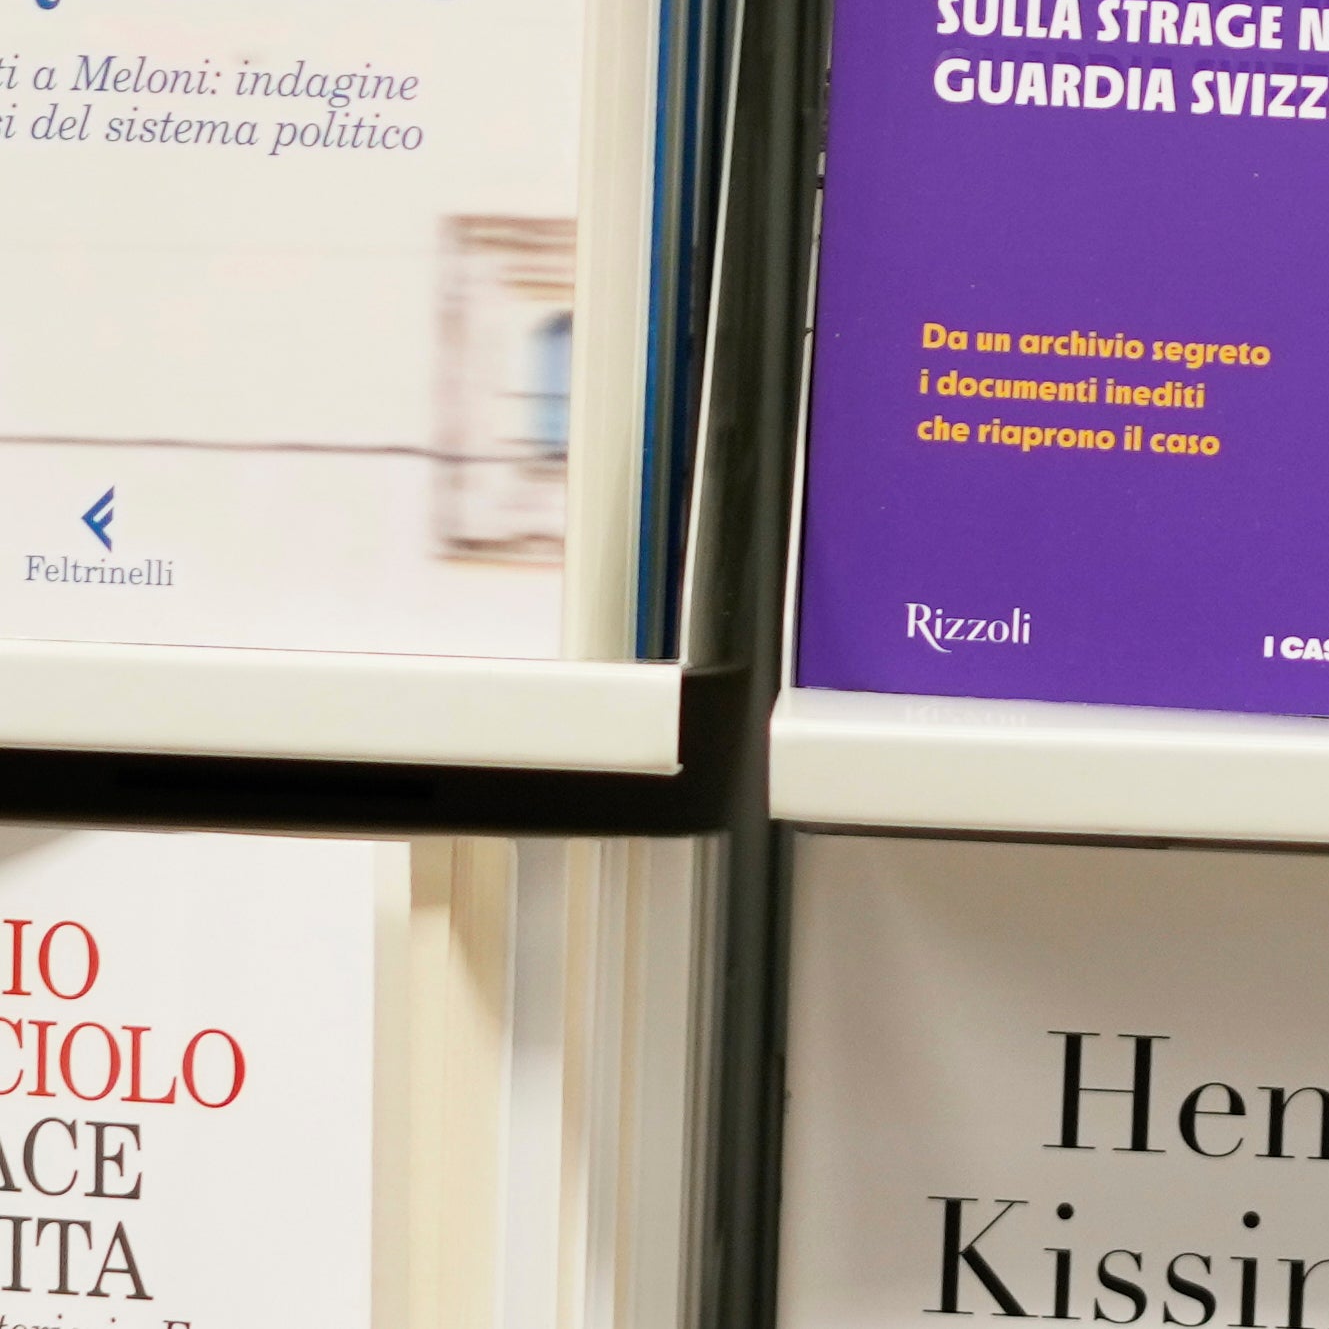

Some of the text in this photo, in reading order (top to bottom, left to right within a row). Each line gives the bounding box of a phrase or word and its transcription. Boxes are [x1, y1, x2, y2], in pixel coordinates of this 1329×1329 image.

[33, 66, 57, 90] a
[69, 54, 220, 96] Meloni:
[234, 57, 419, 108] indagine
[932, 57, 1176, 113] GUARDIA
[31, 103, 93, 141] del
[105, 106, 259, 147] sistema
[269, 110, 425, 157] politico
[921, 322, 1272, 369] Da un archivio segreto
[918, 368, 1206, 409] i documenti inediti
[916, 414, 1221, 456] che riaprono il caso
[24, 555, 174, 587] Feltrinelli
[905, 602, 1032, 653] Rizzoli
[1263, 635, 1273, 659] I
